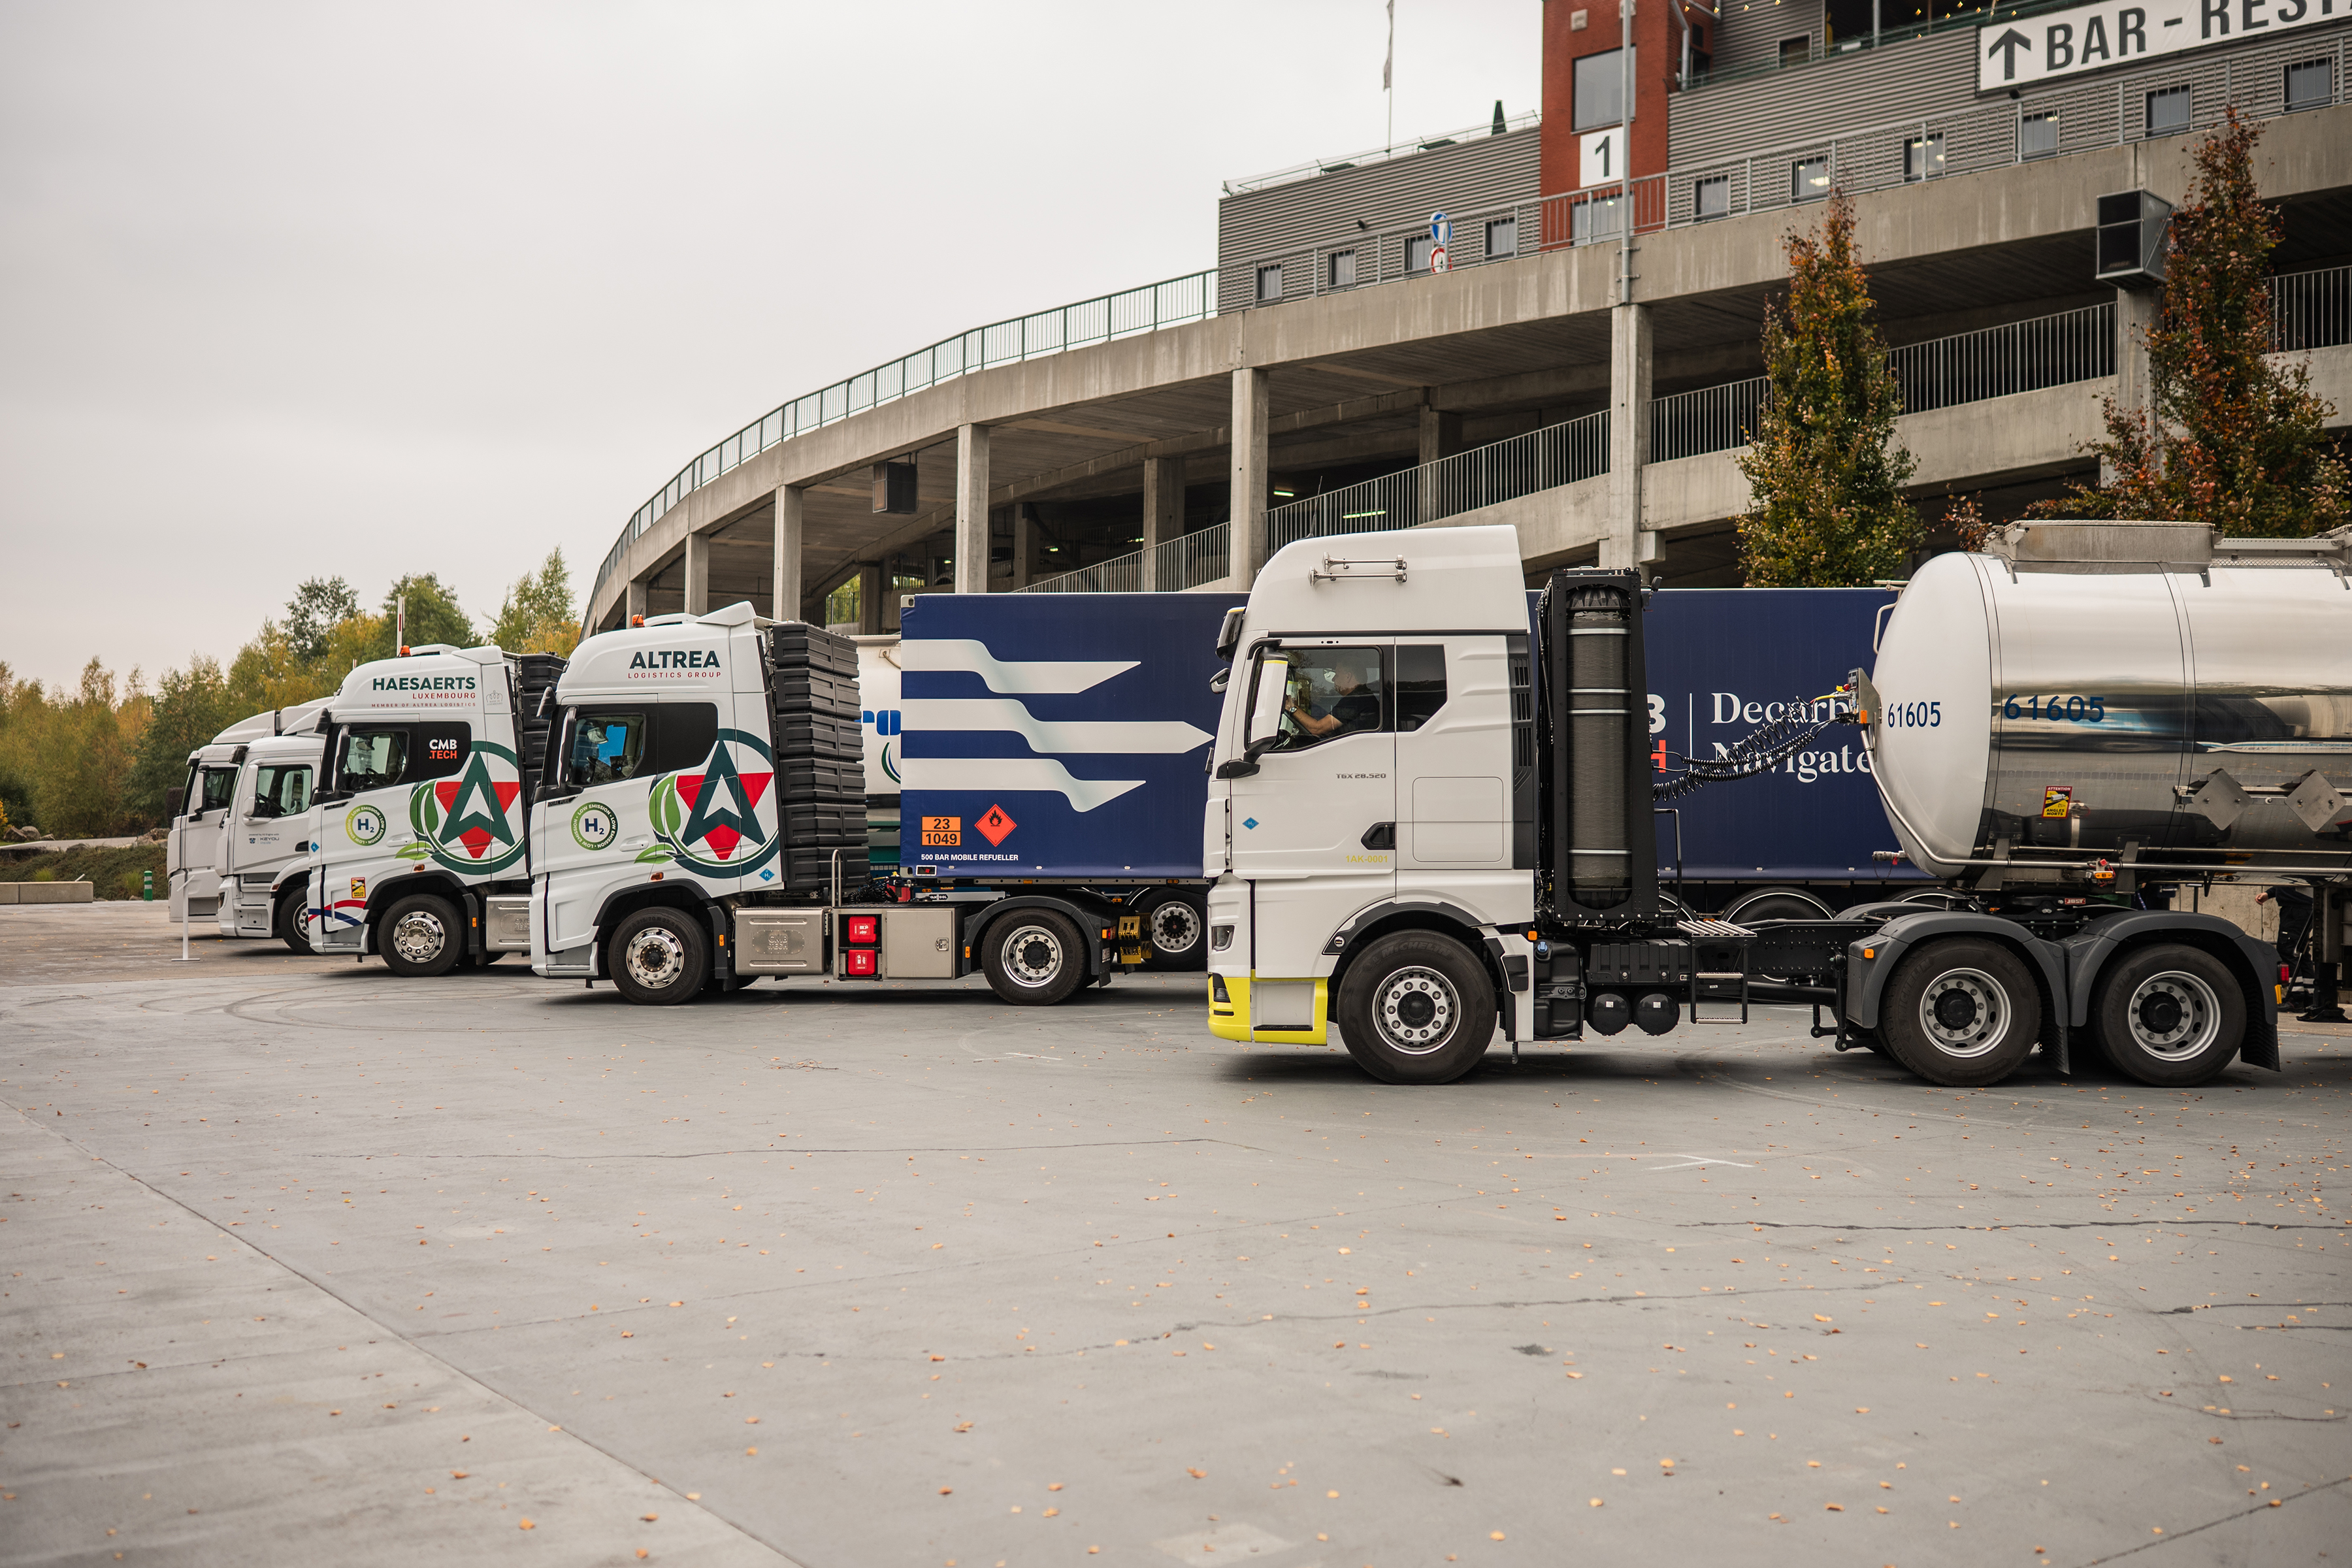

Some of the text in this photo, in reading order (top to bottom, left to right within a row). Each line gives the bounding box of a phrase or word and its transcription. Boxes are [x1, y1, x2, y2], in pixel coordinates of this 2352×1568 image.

[2047, 7, 2147, 71] BAR
[1595, 136, 1610, 177] 1
[629, 651, 721, 669] ALTREA
[372, 677, 476, 691] HAESAERTS
[1887, 701, 1941, 728] 61605
[2004, 694, 2105, 722] 61605
[429, 739, 457, 750] CMB
[429, 750, 457, 759] .TECH
[351, 806, 380, 816] LOW EMISSION
[578, 804, 611, 815] LOW EMISSION
[573, 819, 583, 842] EMISSION
[934, 818, 950, 829] 23
[368, 829, 384, 844] EMISSION
[597, 830, 615, 848] EMISSION
[926, 833, 957, 844] 1049
[768, 935, 788, 943] CMB
[1381, 941, 1452, 958] MICHELIN
